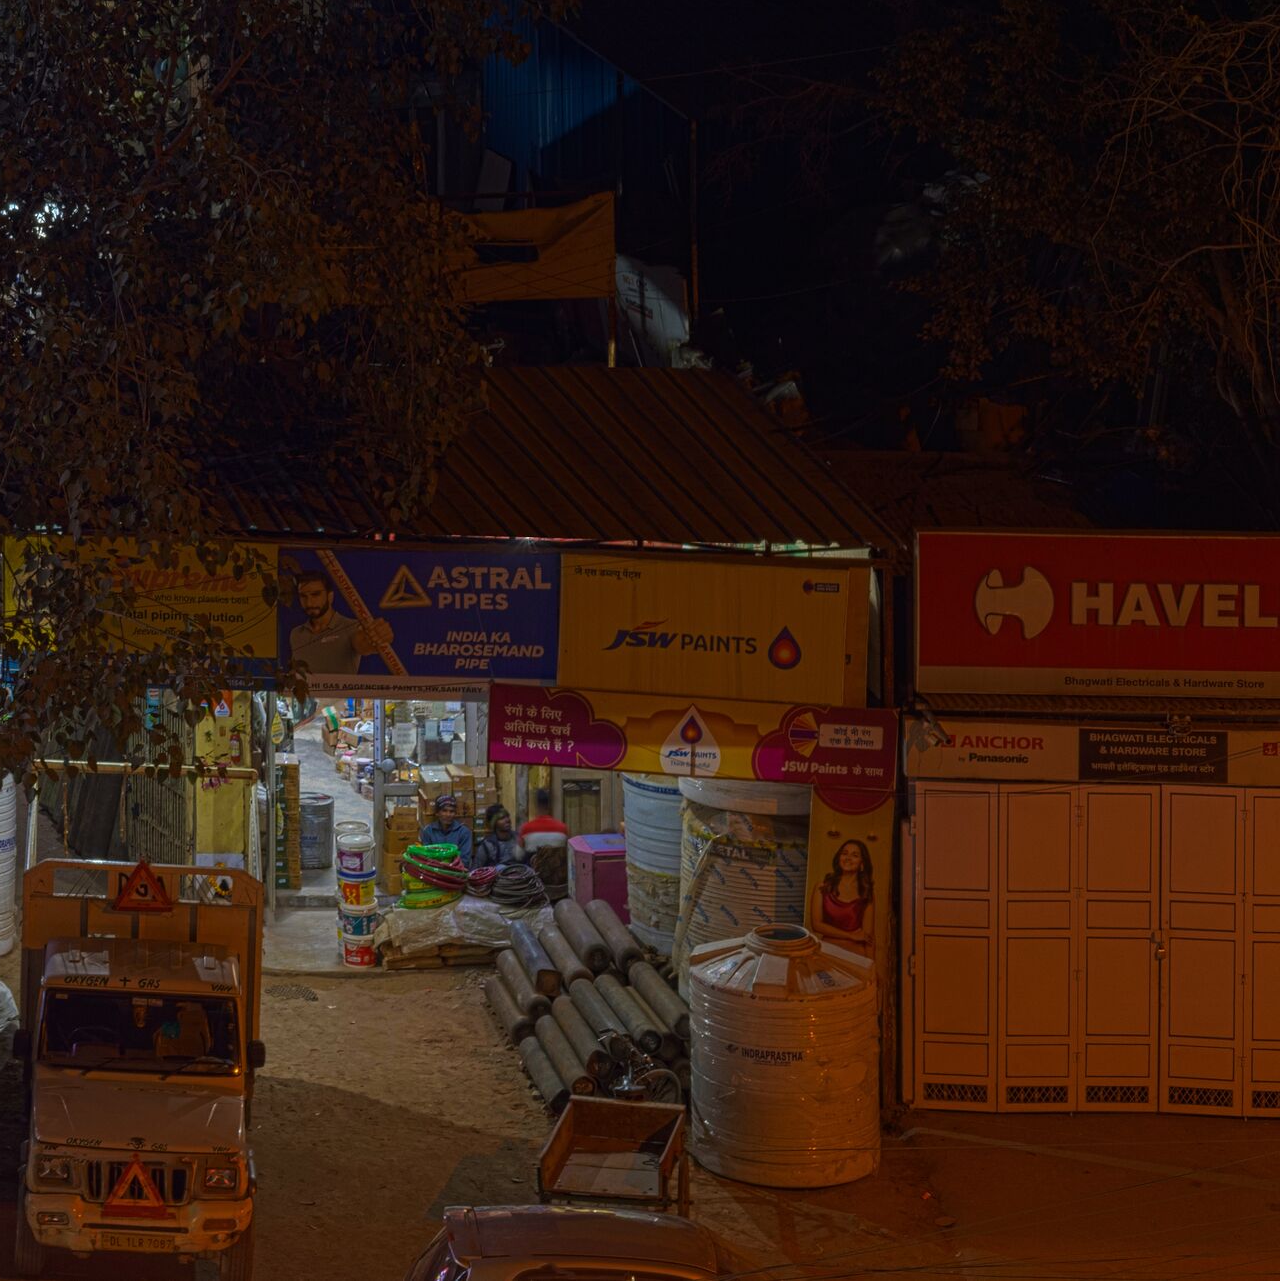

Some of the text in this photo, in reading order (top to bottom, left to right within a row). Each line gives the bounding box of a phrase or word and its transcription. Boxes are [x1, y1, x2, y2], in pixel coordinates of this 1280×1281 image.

[427, 565, 551, 590] ASTRAL
[173, 594, 195, 603] know
[438, 592, 509, 611] PIPES
[1071, 581, 1279, 628] HAVEL
[122, 609, 147, 620] otal
[193, 611, 244, 623] slution
[446, 630, 511, 644] INDIA KA
[602, 625, 757, 654] JSW PAINTS
[413, 642, 545, 658] BHAROSEMAND
[455, 658, 489, 670] PIPE
[1064, 676, 1265, 689] Bhagwati Electricals & Hardware Store
[959, 735, 1044, 751] ANCHOR
[1089, 732, 1144, 745] BHAGWATI
[692, 751, 718, 761] AINTS
[968, 752, 1029, 765] Panasonic
[1099, 745, 1207, 758] & HARDWARE STORE
[781, 760, 809, 773] JSW
[811, 761, 848, 775] Paints
[64, 975, 109, 988] OXYGEN
[137, 977, 161, 990] GAS
[741, 1046, 804, 1062] INDRAPRASTHA
[109, 1236, 123, 1248] DL
